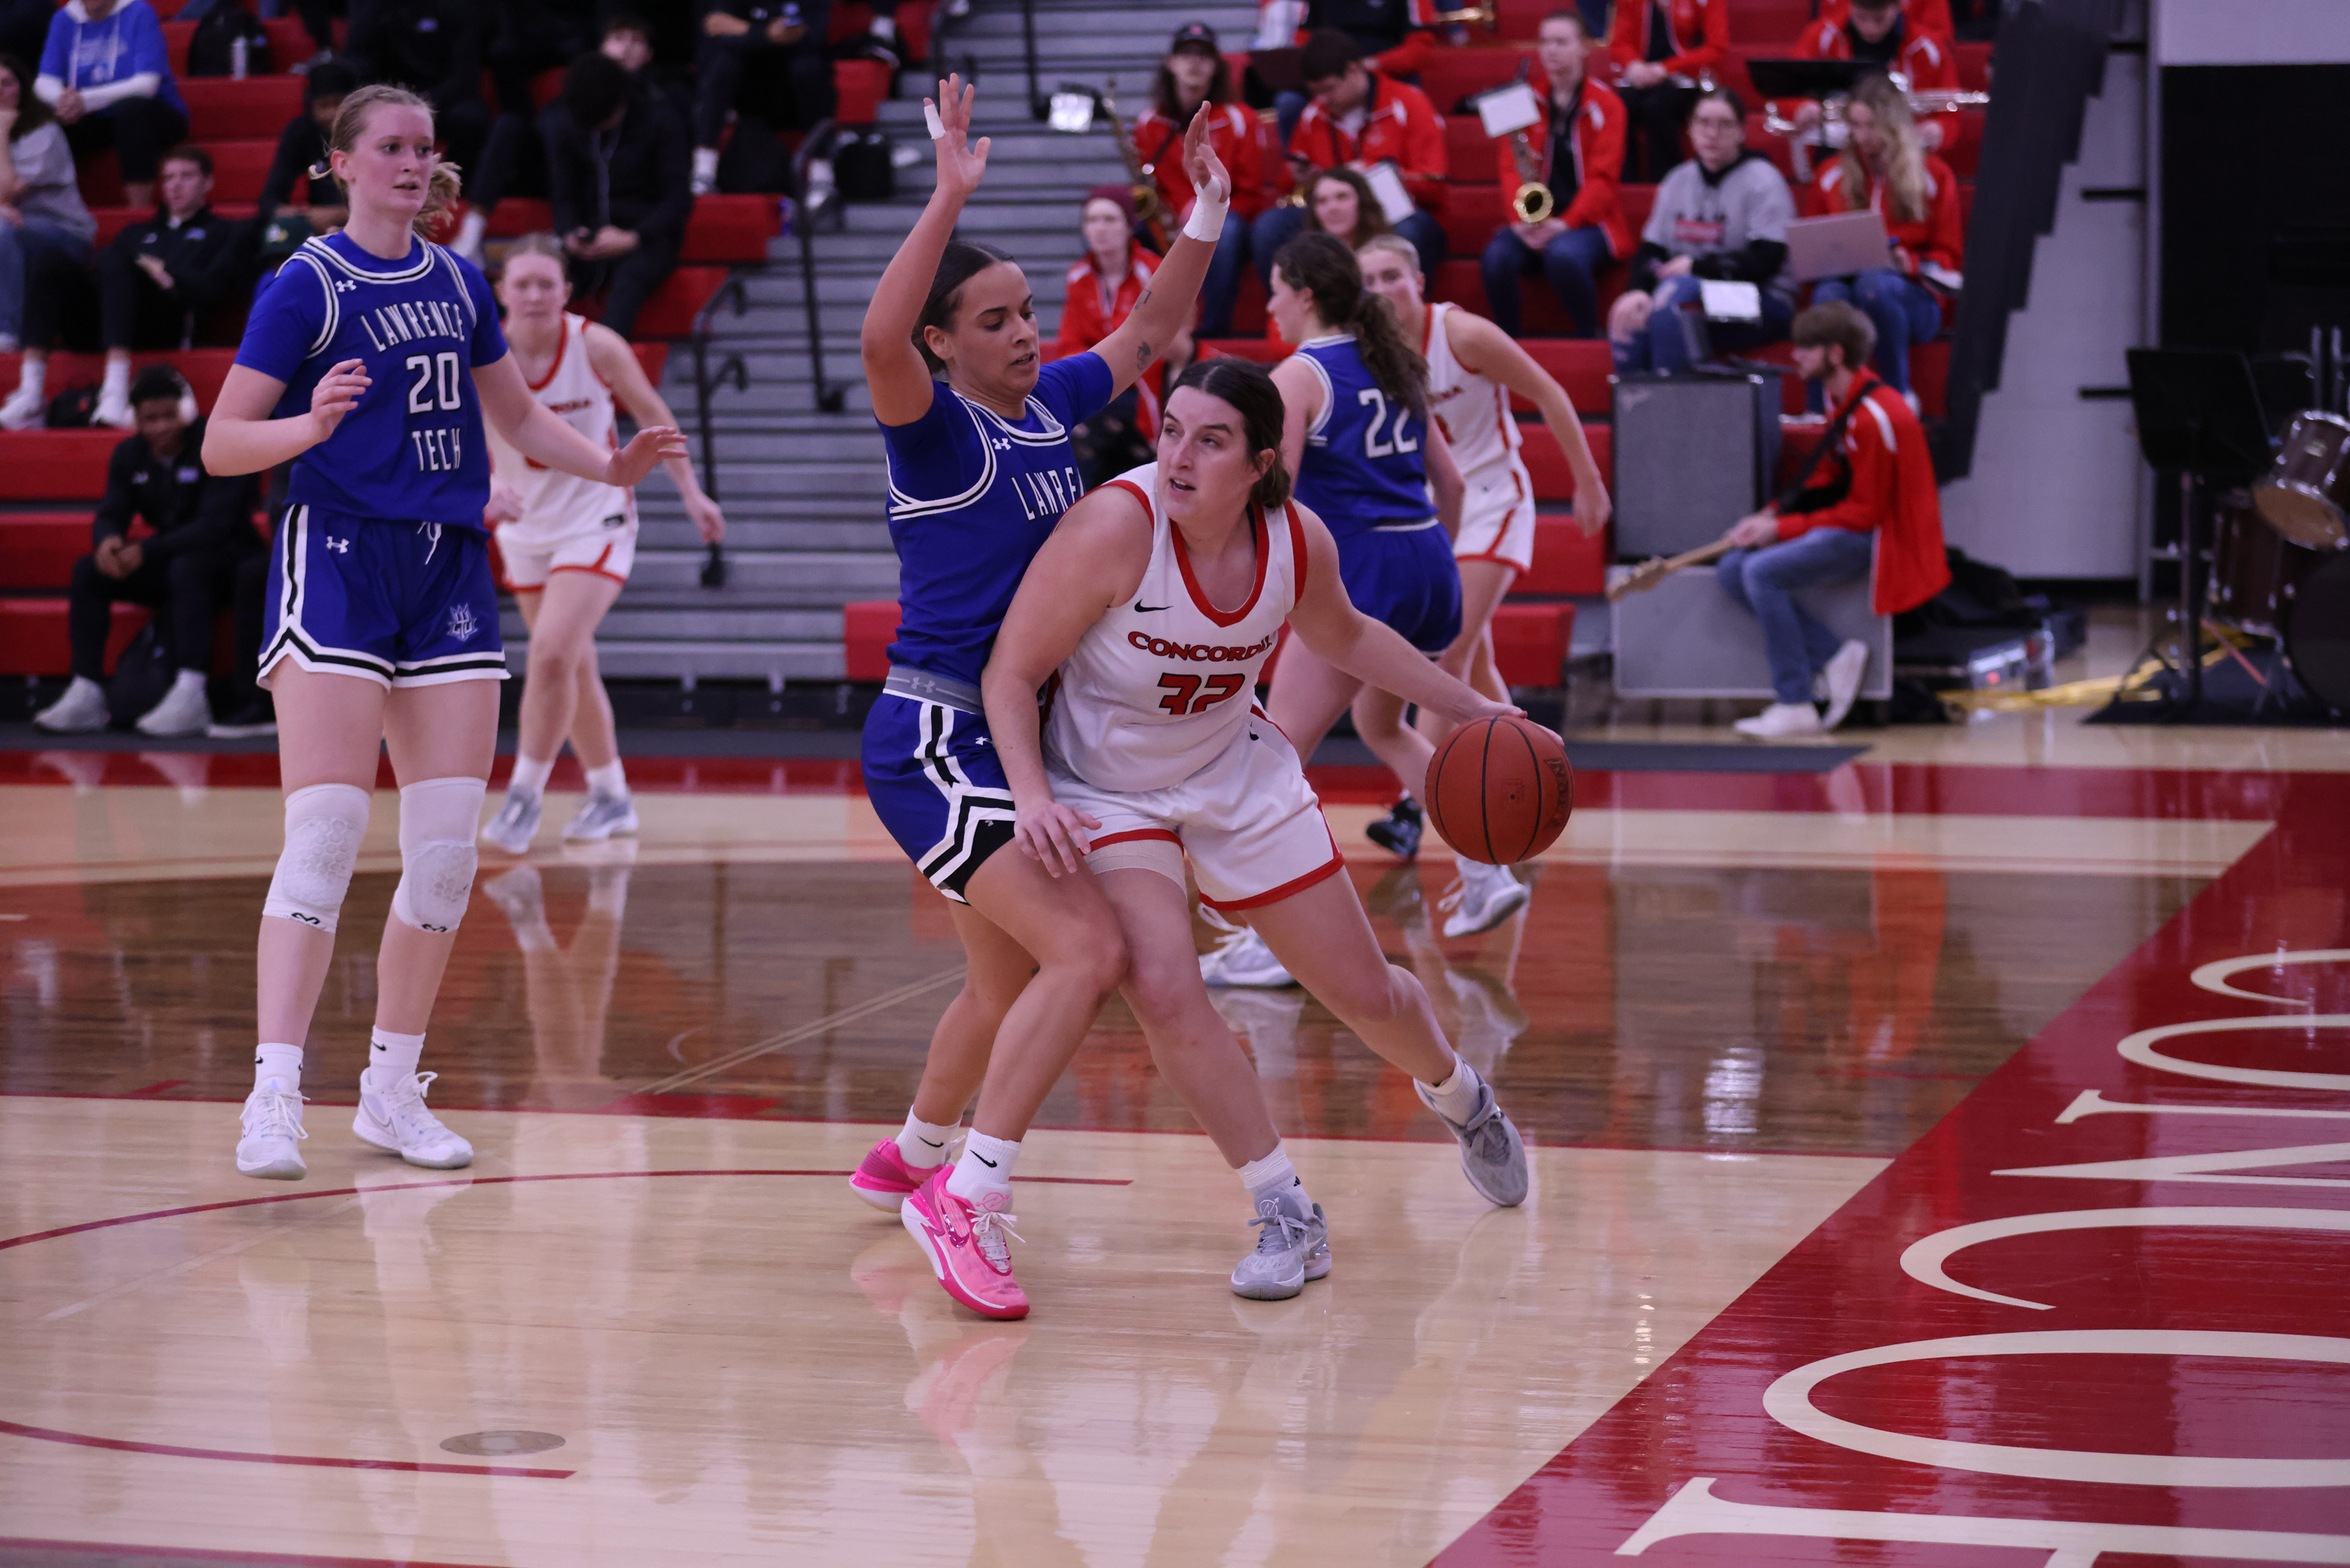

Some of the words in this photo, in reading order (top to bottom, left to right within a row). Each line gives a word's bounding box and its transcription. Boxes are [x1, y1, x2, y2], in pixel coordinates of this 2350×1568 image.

[360, 300, 465, 353] LAWRENCE
[405, 351, 462, 414] 20
[411, 427, 461, 472] TECH
[1357, 387, 1418, 459] 22
[1011, 466, 1085, 521] LAWRE
[1157, 672, 1246, 715] 32
